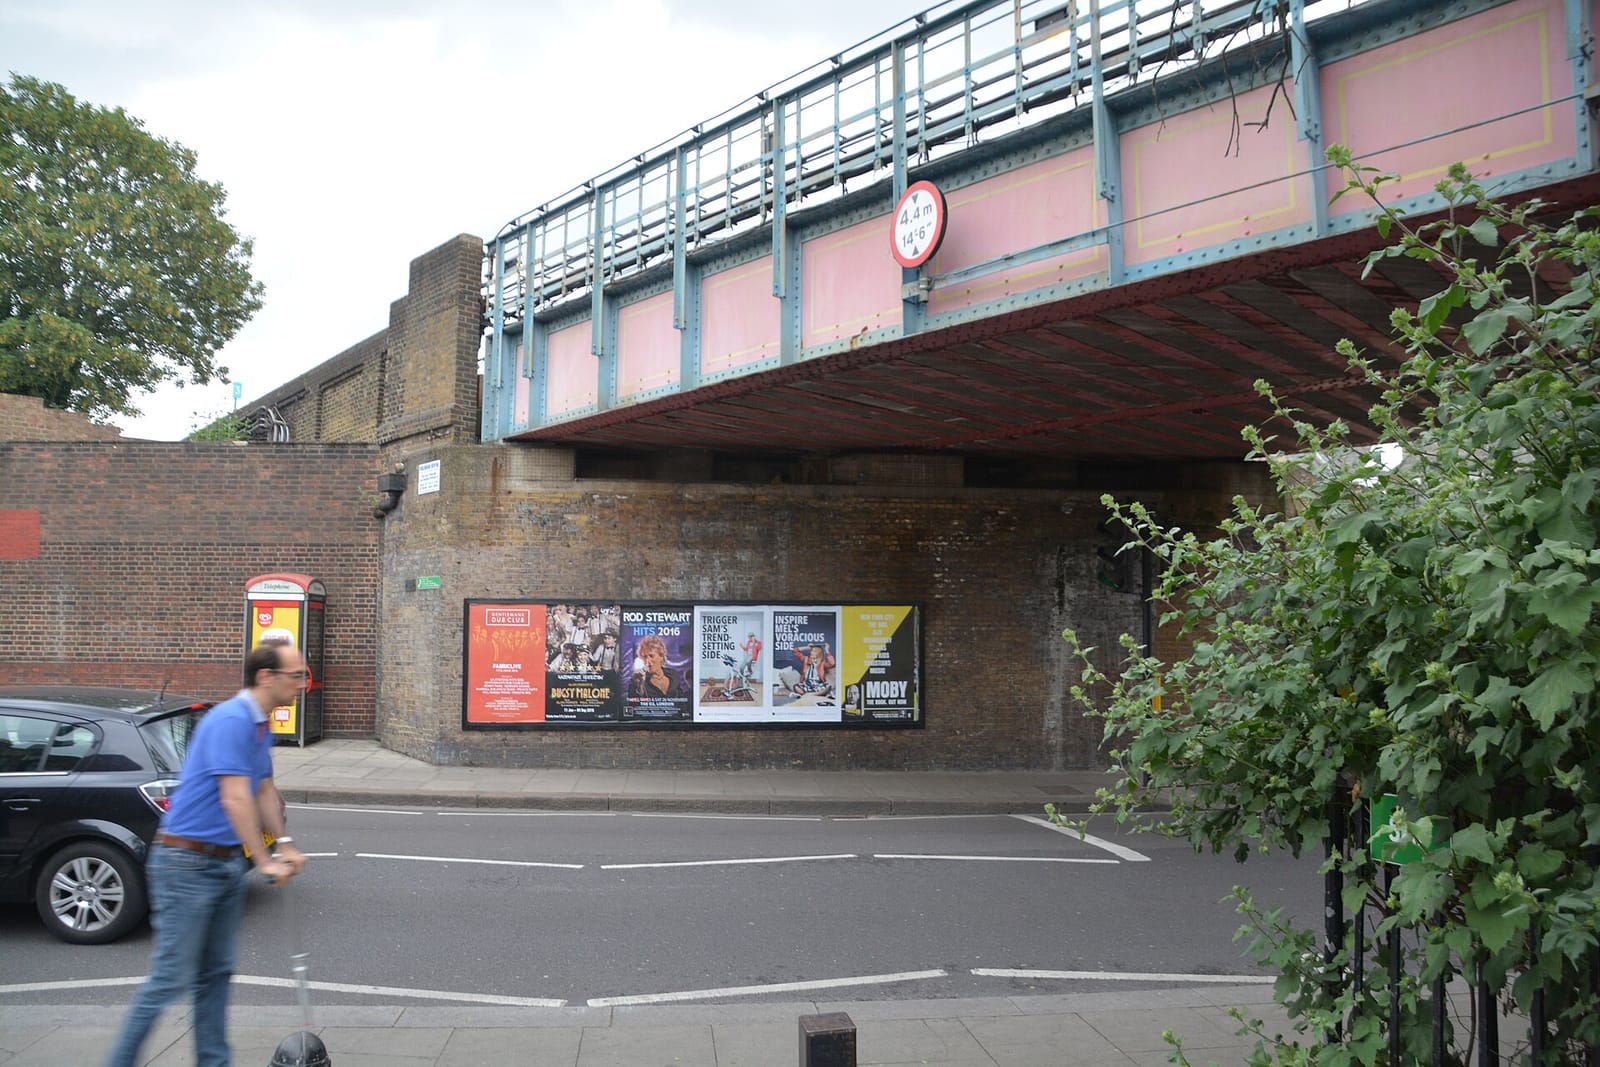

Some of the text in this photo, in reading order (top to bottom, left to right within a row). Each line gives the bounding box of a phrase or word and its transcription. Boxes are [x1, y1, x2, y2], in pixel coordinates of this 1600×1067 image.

[900, 203, 933, 225] 4.4 m
[623, 612, 692, 622] ROD STEWART
[702, 615, 738, 624] TRIGGER
[775, 615, 809, 625] INSPIRE
[633, 627, 681, 636] HITS 2016
[702, 624, 728, 633] SAM'S
[775, 624, 799, 633] MEL'S
[702, 633, 732, 642] TREND-
[775, 632, 825, 642] VORACIOUS
[702, 642, 735, 651] SETTING
[775, 641, 794, 651] SIDE
[702, 650, 721, 659] SIDE
[551, 687, 611, 699] BUGSY MALONE
[866, 680, 908, 698] MOBY
